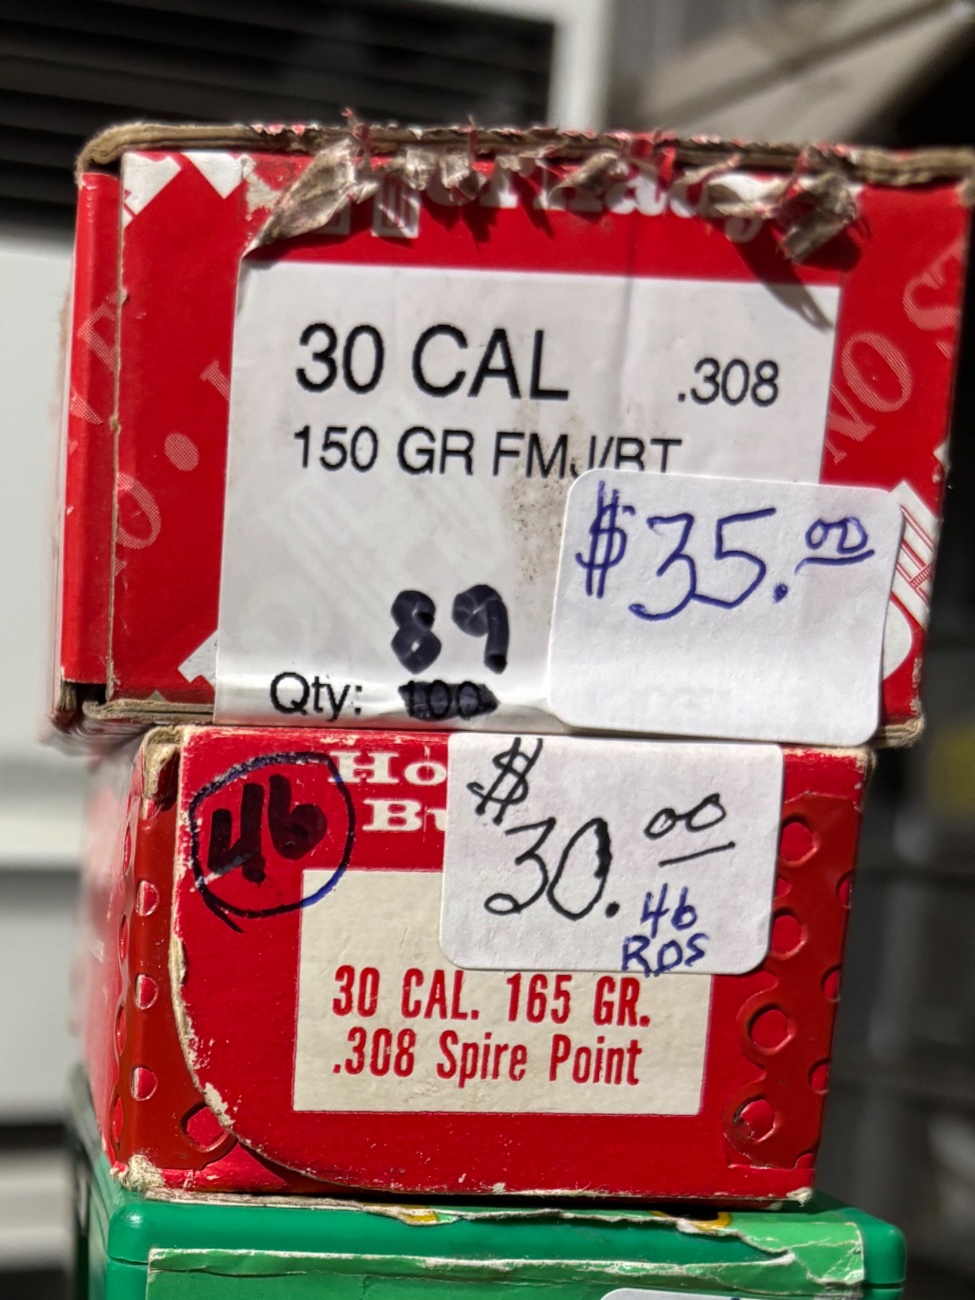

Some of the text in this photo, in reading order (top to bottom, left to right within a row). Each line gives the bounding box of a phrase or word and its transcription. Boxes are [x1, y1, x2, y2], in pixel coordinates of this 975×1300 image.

[296, 322, 780, 407] 30 CAL .308
[294, 425, 379, 473] 150
[396, 426, 475, 476] GR
[390, 584, 510, 674] 89
[269, 671, 363, 723] Qty:
[207, 774, 327, 886] 46
[640, 882, 698, 938] 46
[332, 965, 651, 1028] 30 CAL. 165 GR.
[332, 1026, 643, 1089] .308 Spire Point
